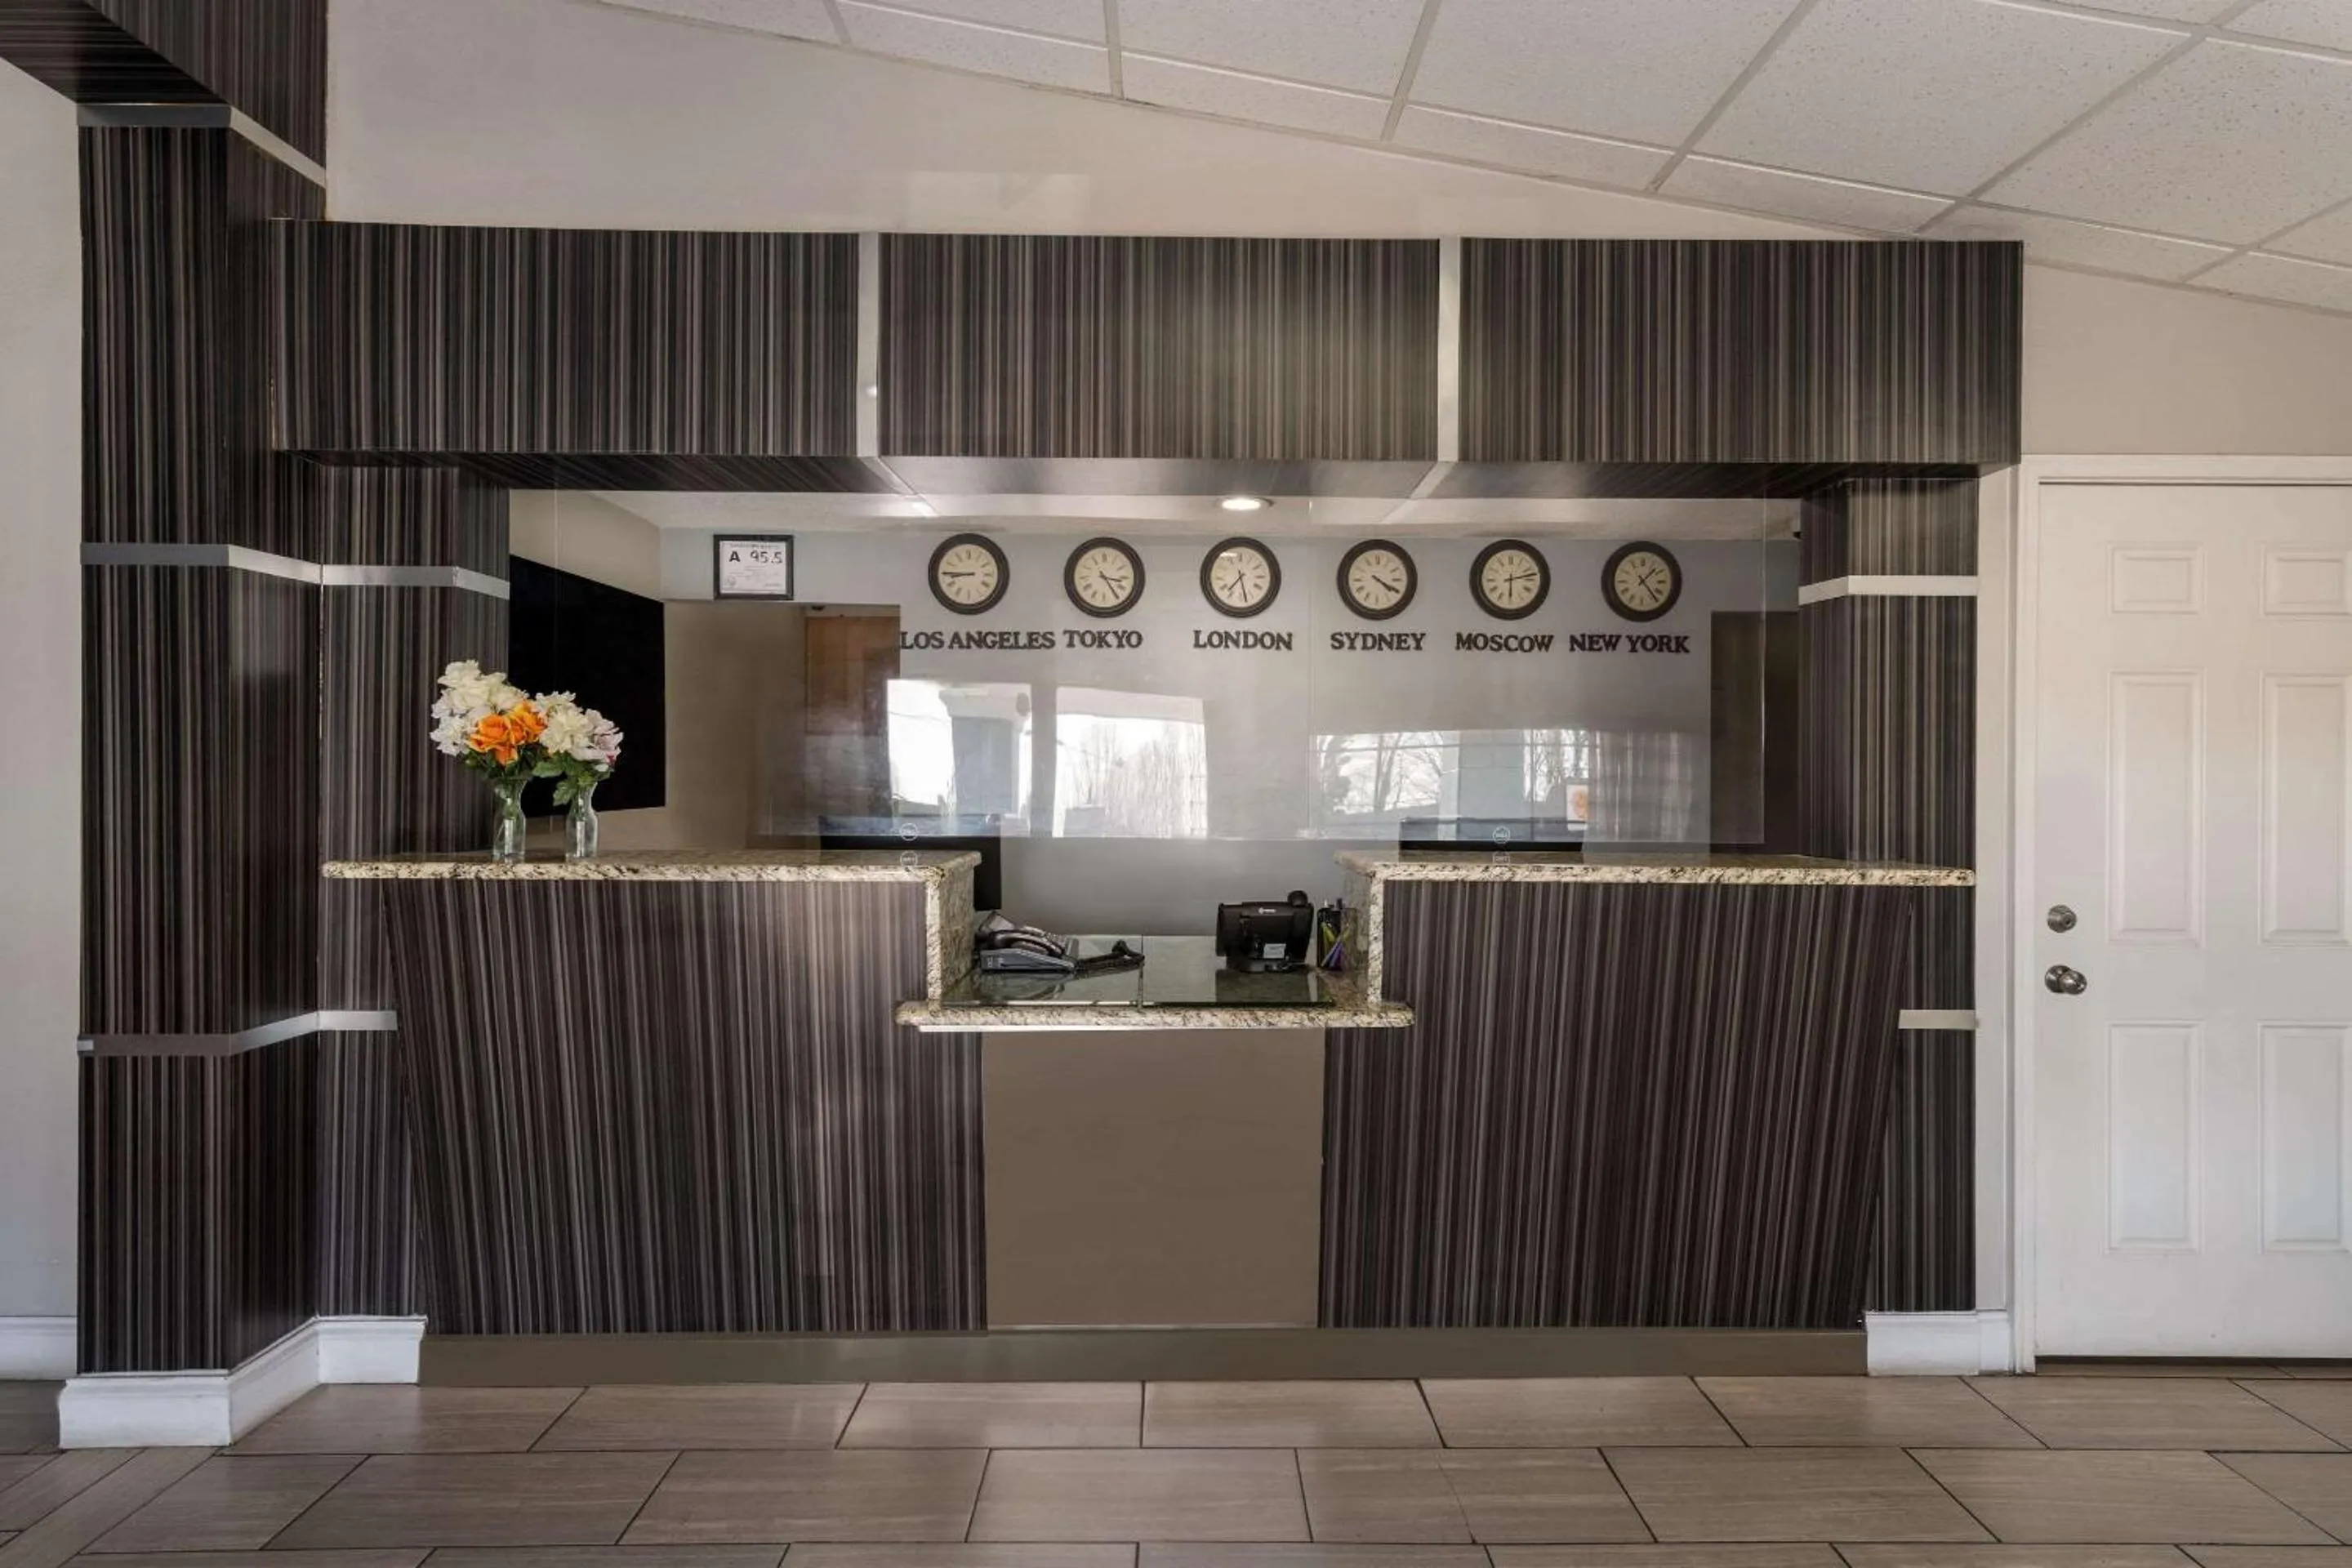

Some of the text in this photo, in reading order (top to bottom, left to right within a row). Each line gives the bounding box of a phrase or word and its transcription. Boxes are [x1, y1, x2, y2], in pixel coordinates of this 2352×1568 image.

[728, 550, 741, 563] A
[901, 630, 1055, 649] LOS ANGELES
[1063, 630, 1143, 648] TOKYO
[1192, 630, 1293, 651] LONDON
[1330, 631, 1426, 651] SYDNEY
[1455, 632, 1554, 653] MOSCOW
[1569, 633, 1690, 653] NEW YORK
